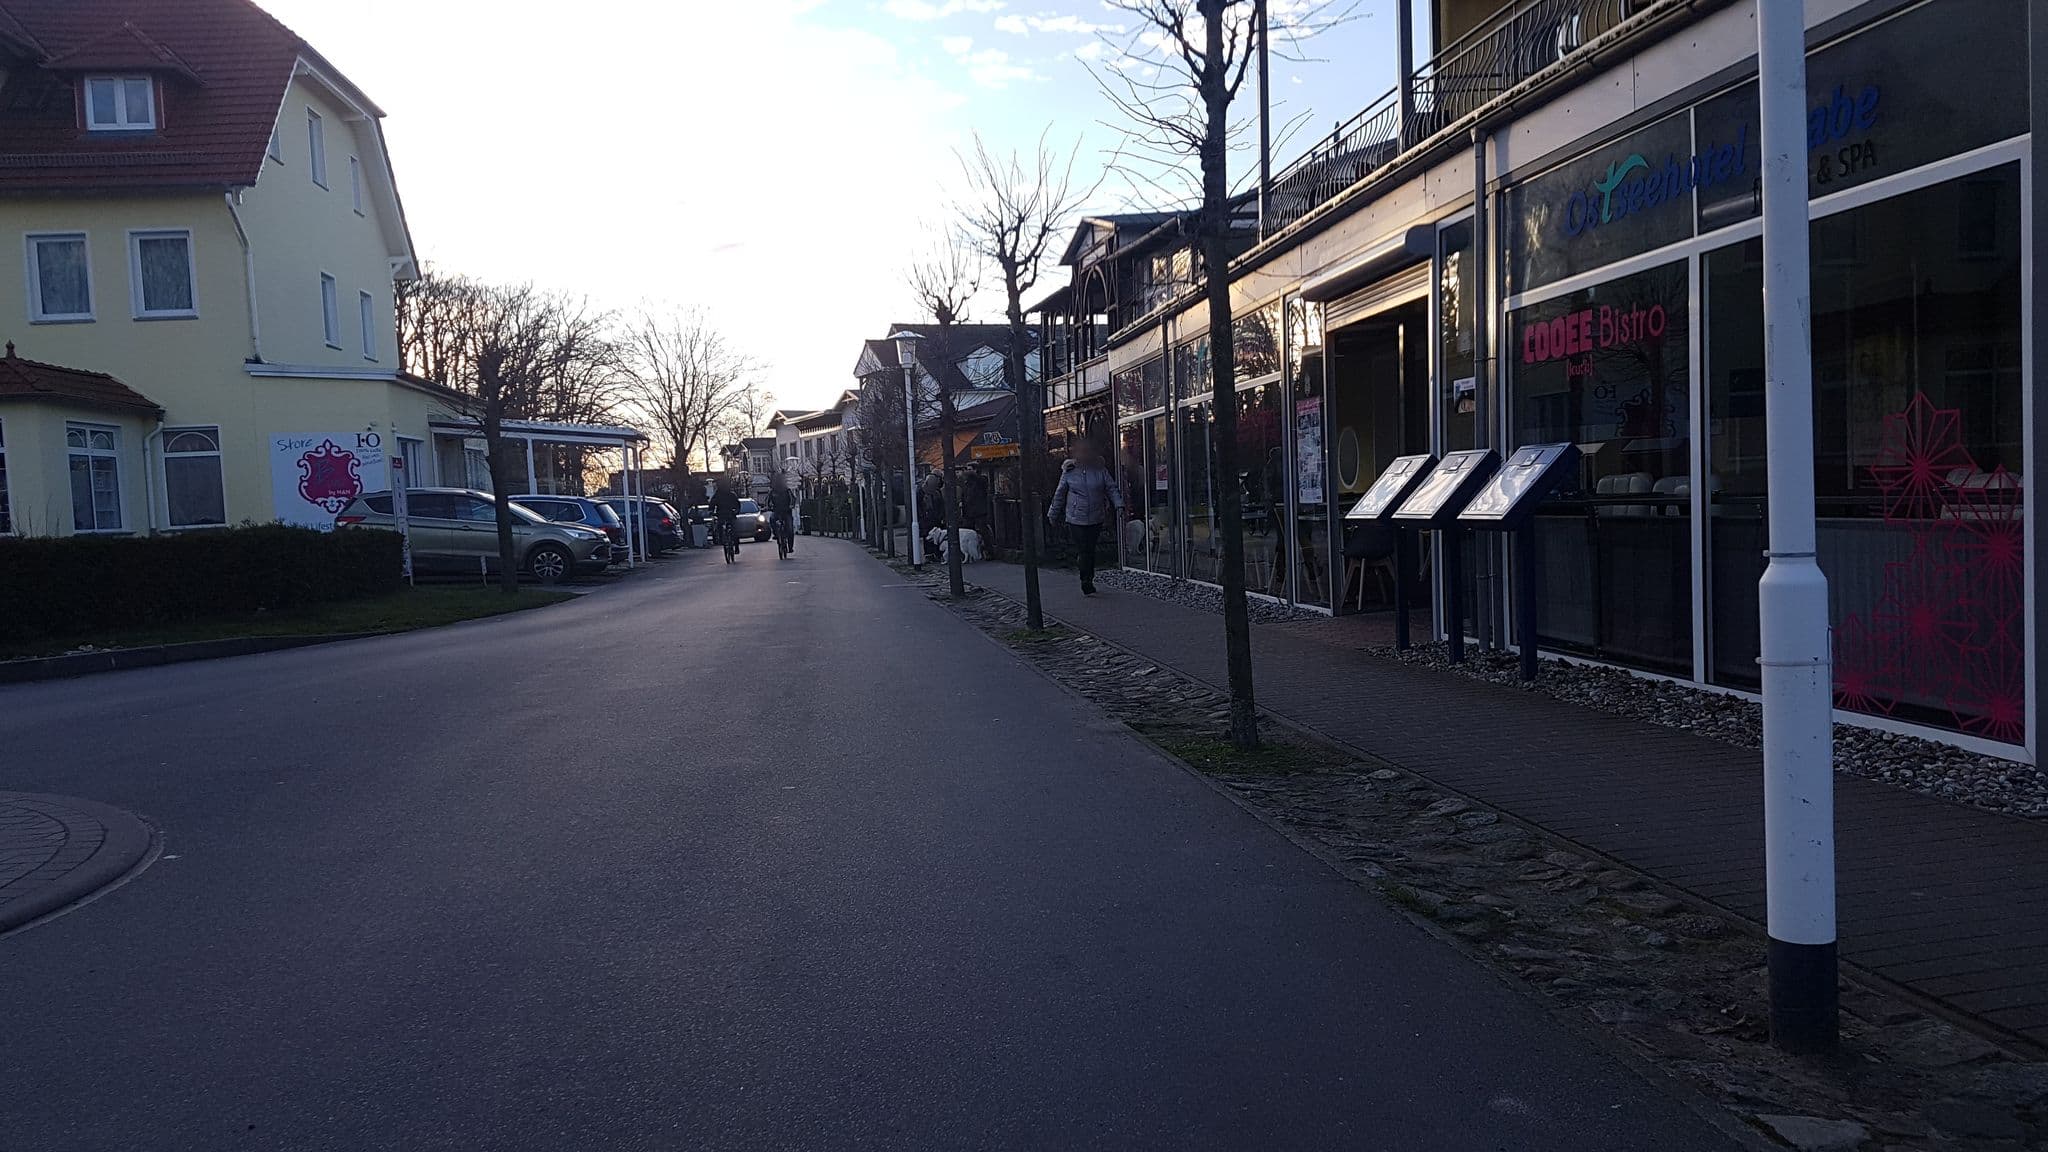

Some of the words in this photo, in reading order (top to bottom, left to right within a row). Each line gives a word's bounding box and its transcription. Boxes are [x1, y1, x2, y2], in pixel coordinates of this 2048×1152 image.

[1838, 138, 1877, 178] SPA
[1566, 126, 1747, 237] Ostseehotel
[1599, 301, 1667, 349] Bistro
[276, 437, 313, 452] Store
